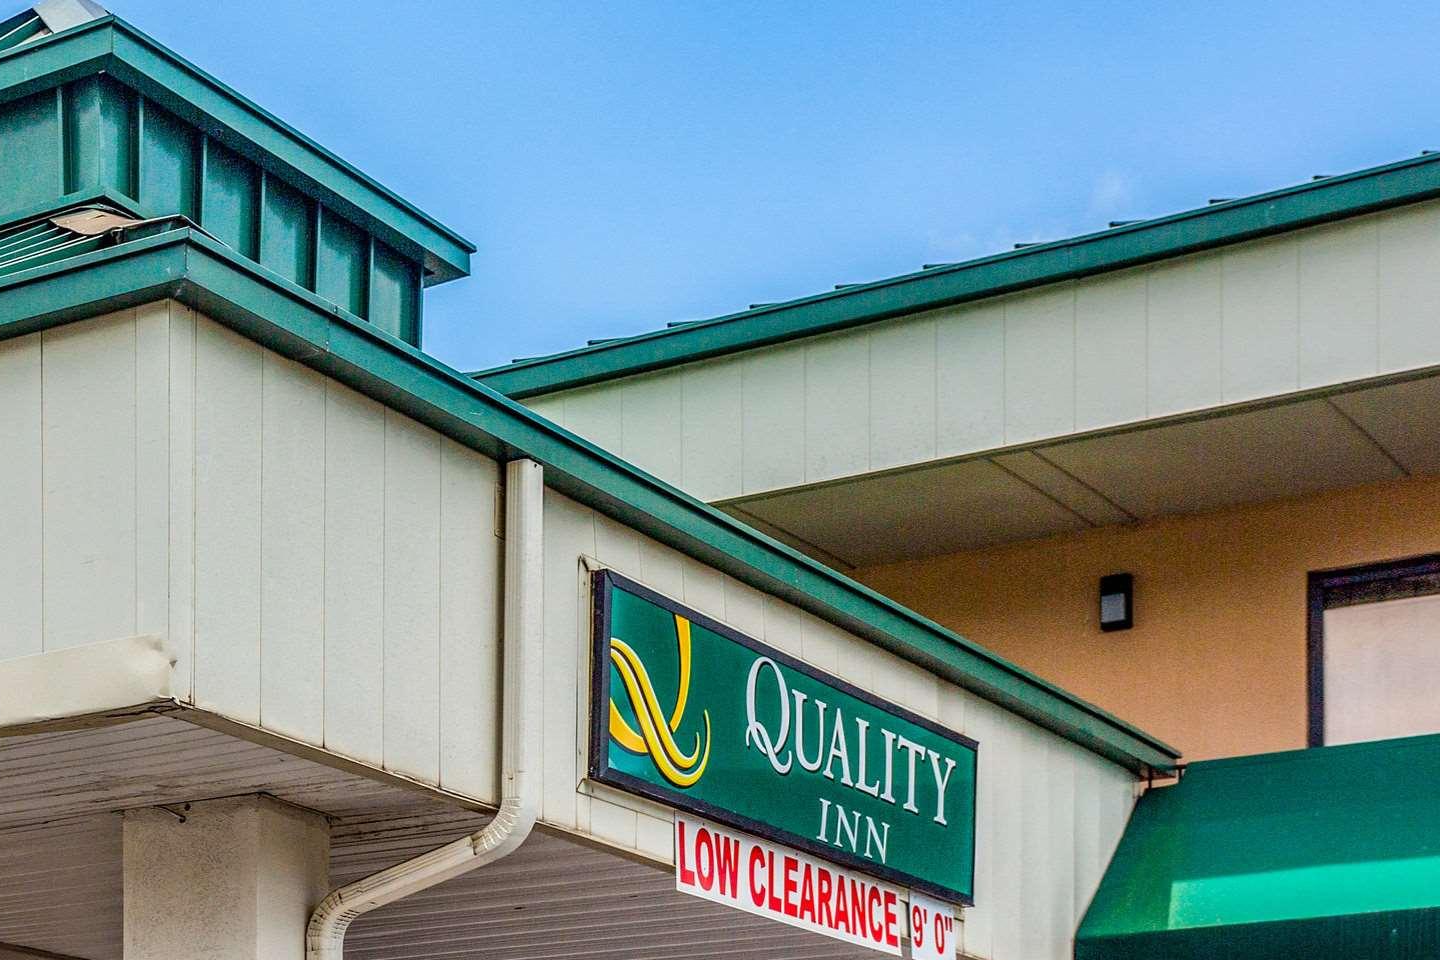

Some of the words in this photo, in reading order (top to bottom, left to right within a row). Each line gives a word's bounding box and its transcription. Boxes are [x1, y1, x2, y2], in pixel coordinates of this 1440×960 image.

[746, 656, 957, 827] QUALITY
[678, 821, 741, 900] LOW
[749, 845, 899, 948] CLEARANCE
[816, 798, 891, 865] INN
